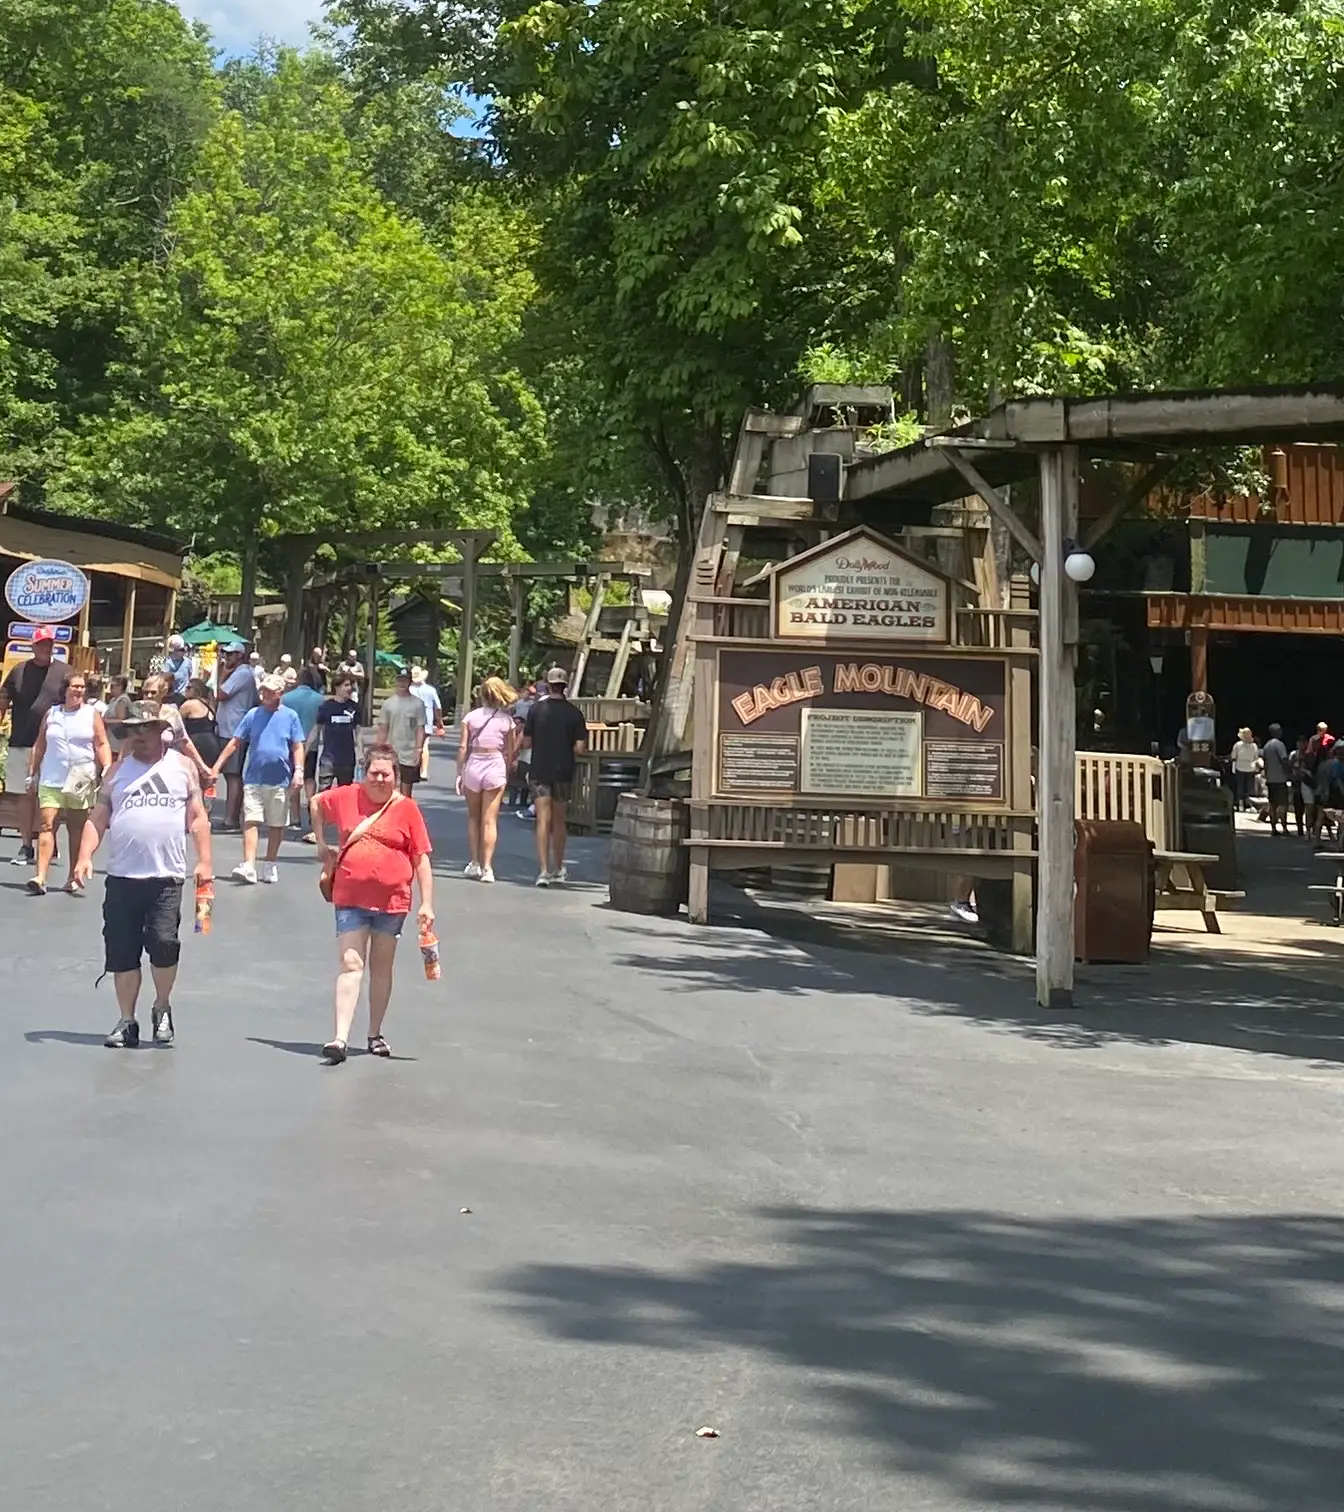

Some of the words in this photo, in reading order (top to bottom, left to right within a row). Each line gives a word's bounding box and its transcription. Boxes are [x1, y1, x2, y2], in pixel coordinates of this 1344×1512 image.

[23, 573, 73, 595] SUMMER
[824, 574, 854, 584] PROUDLY
[856, 575, 887, 585] PRESENTS
[17, 592, 77, 607] CELEBRATION
[806, 597, 921, 613] AMERICAN
[790, 611, 847, 625] BALD
[851, 613, 936, 628] EAGLES
[731, 666, 824, 726] EAGLE
[833, 663, 995, 733] MOUNTAIN
[125, 796, 176, 809] adidas
